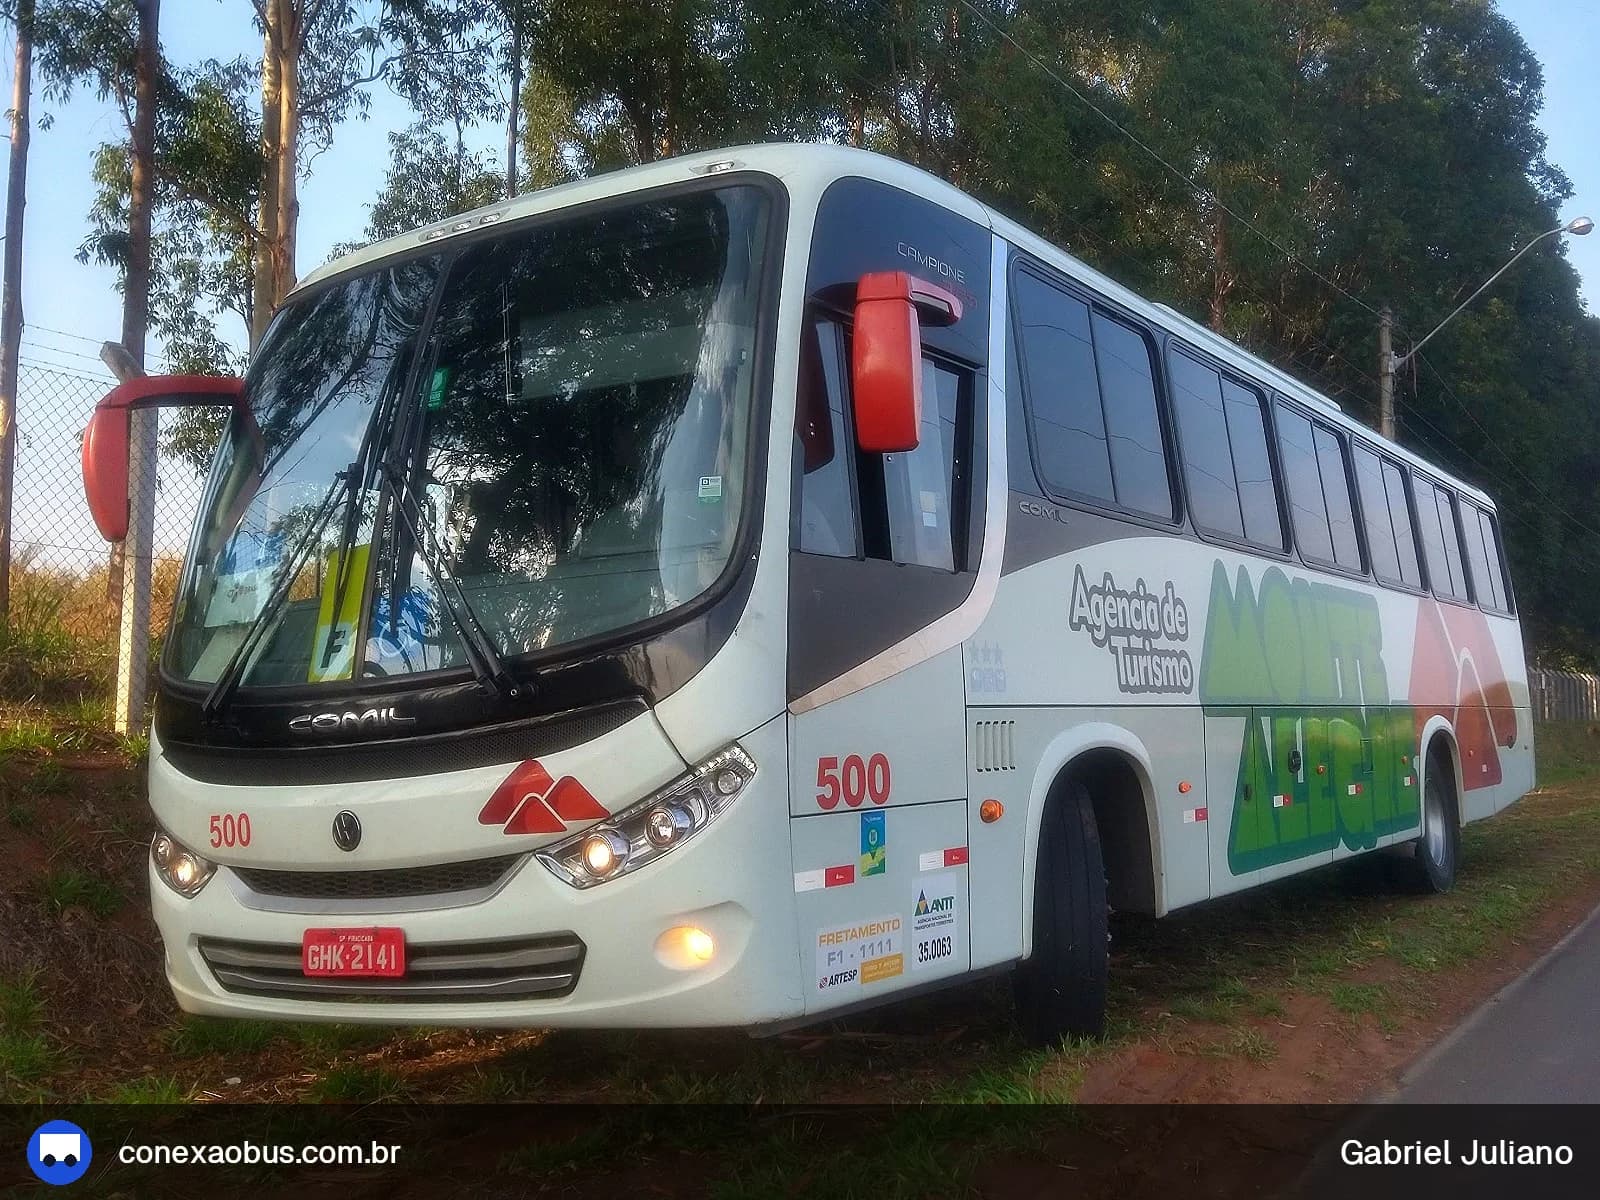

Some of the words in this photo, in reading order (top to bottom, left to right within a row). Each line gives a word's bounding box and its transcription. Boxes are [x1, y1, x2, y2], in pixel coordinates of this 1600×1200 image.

[896, 241, 966, 284] CAMPIONE
[1018, 500, 1068, 525] COMIL
[1069, 563, 1162, 648] Agência
[1161, 580, 1188, 642] de
[1200, 559, 1389, 706] MONTE
[1108, 635, 1193, 694] Turismo
[288, 706, 416, 734] COMIL
[815, 752, 891, 811] 500
[209, 812, 251, 849] 500
[930, 895, 955, 914] ANTT
[818, 918, 901, 947] FRETAMENTO
[827, 949, 843, 967] F1
[859, 938, 892, 959] 1111
[918, 935, 952, 963] 35.0063
[828, 969, 858, 987] ARTESP
